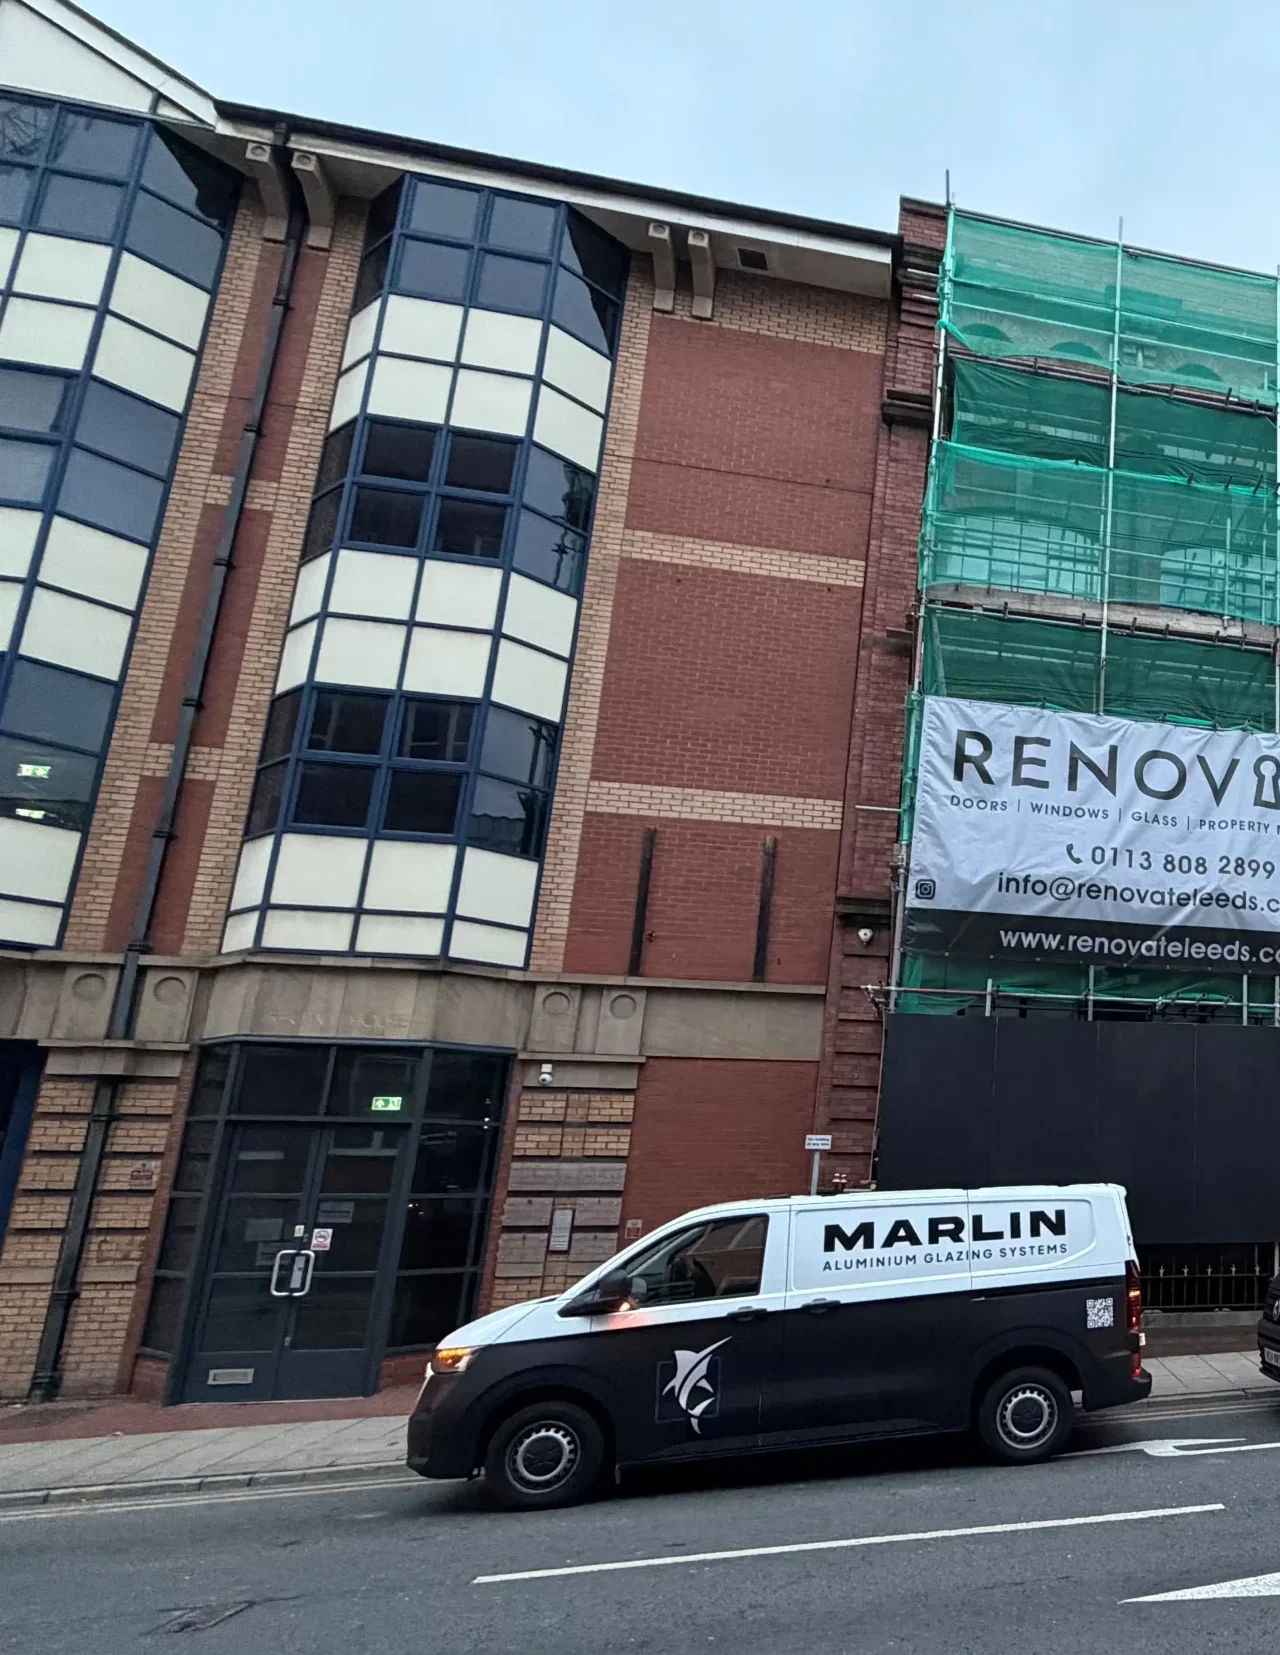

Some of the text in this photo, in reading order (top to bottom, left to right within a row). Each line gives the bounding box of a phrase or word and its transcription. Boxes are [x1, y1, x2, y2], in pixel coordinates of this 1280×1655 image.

[950, 795, 1008, 811] DOORS
[1030, 802, 1110, 820] WINDOWS
[1131, 811, 1178, 827] GLASS
[1199, 819, 1271, 834] PROPERTY
[1091, 845, 1276, 880] 0113 808 2899
[823, 1209, 1067, 1253] MARLIN
[822, 1243, 1068, 1272] ALUMINIUM GLAZING SYSTEMS
